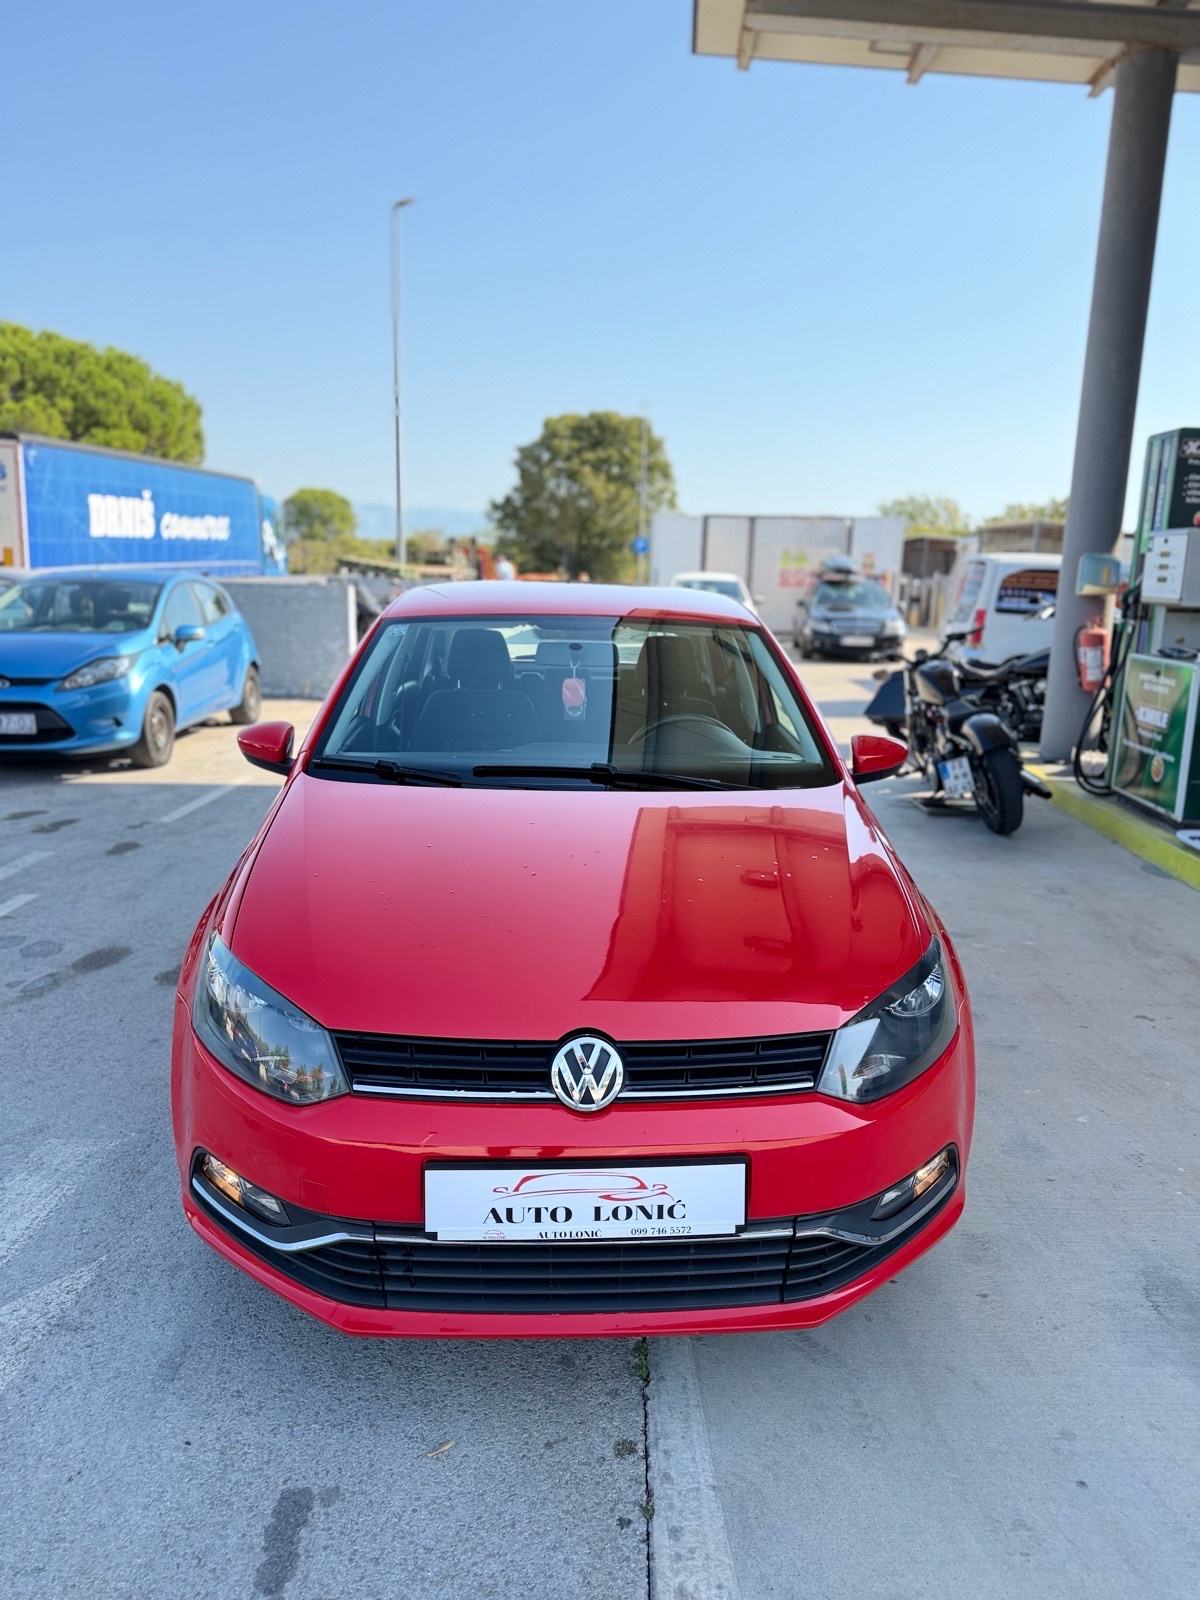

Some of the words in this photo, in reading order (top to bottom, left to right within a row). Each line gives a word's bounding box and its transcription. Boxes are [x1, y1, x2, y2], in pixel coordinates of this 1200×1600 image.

[482, 1206, 573, 1224] AUTO
[593, 1199, 687, 1222] LONIĆ
[537, 1231, 567, 1239] AUTO
[631, 1227, 648, 1236] 099
[650, 1226, 668, 1235] 746
[669, 1225, 693, 1234] 5572
